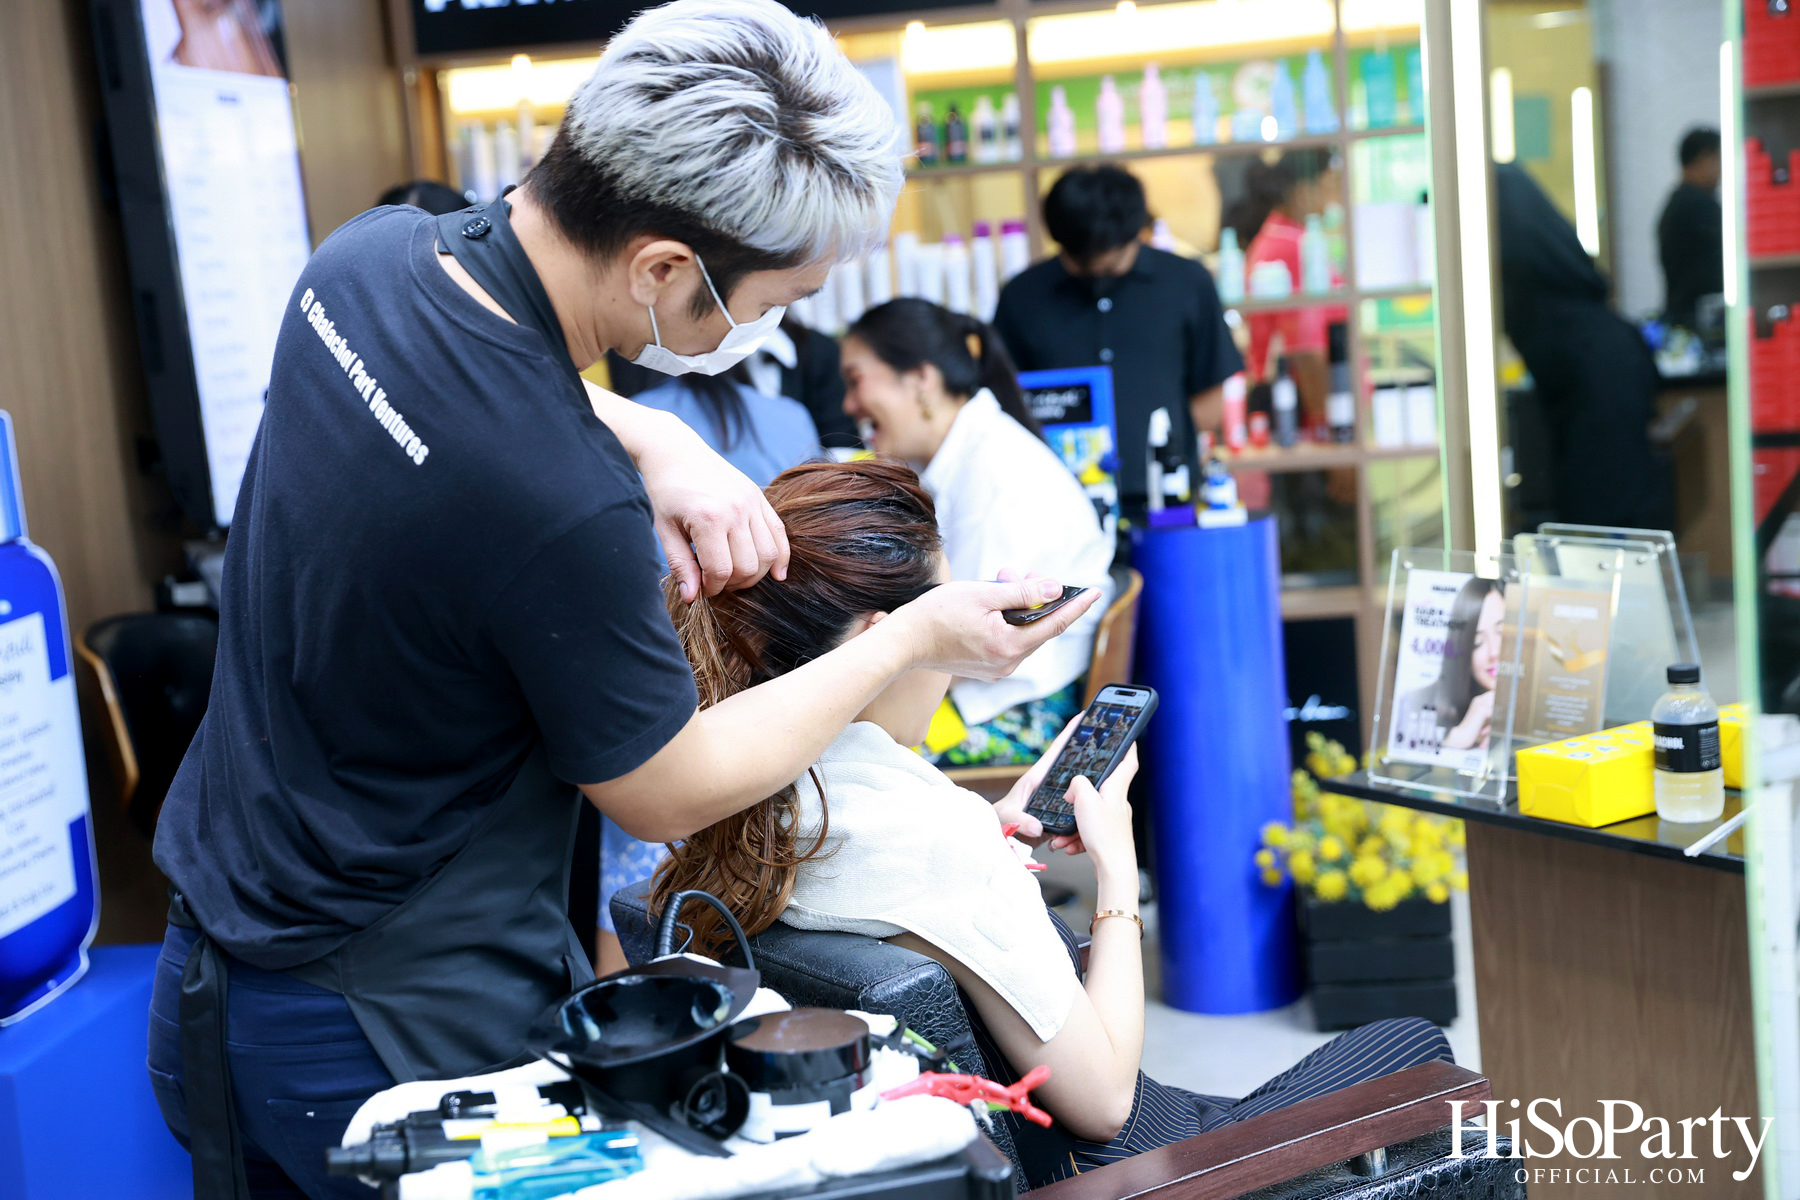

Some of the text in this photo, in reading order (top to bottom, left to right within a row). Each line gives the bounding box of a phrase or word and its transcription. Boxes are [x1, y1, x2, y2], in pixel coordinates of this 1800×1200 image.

[307, 301, 430, 466] Chalachol Park Ventures
